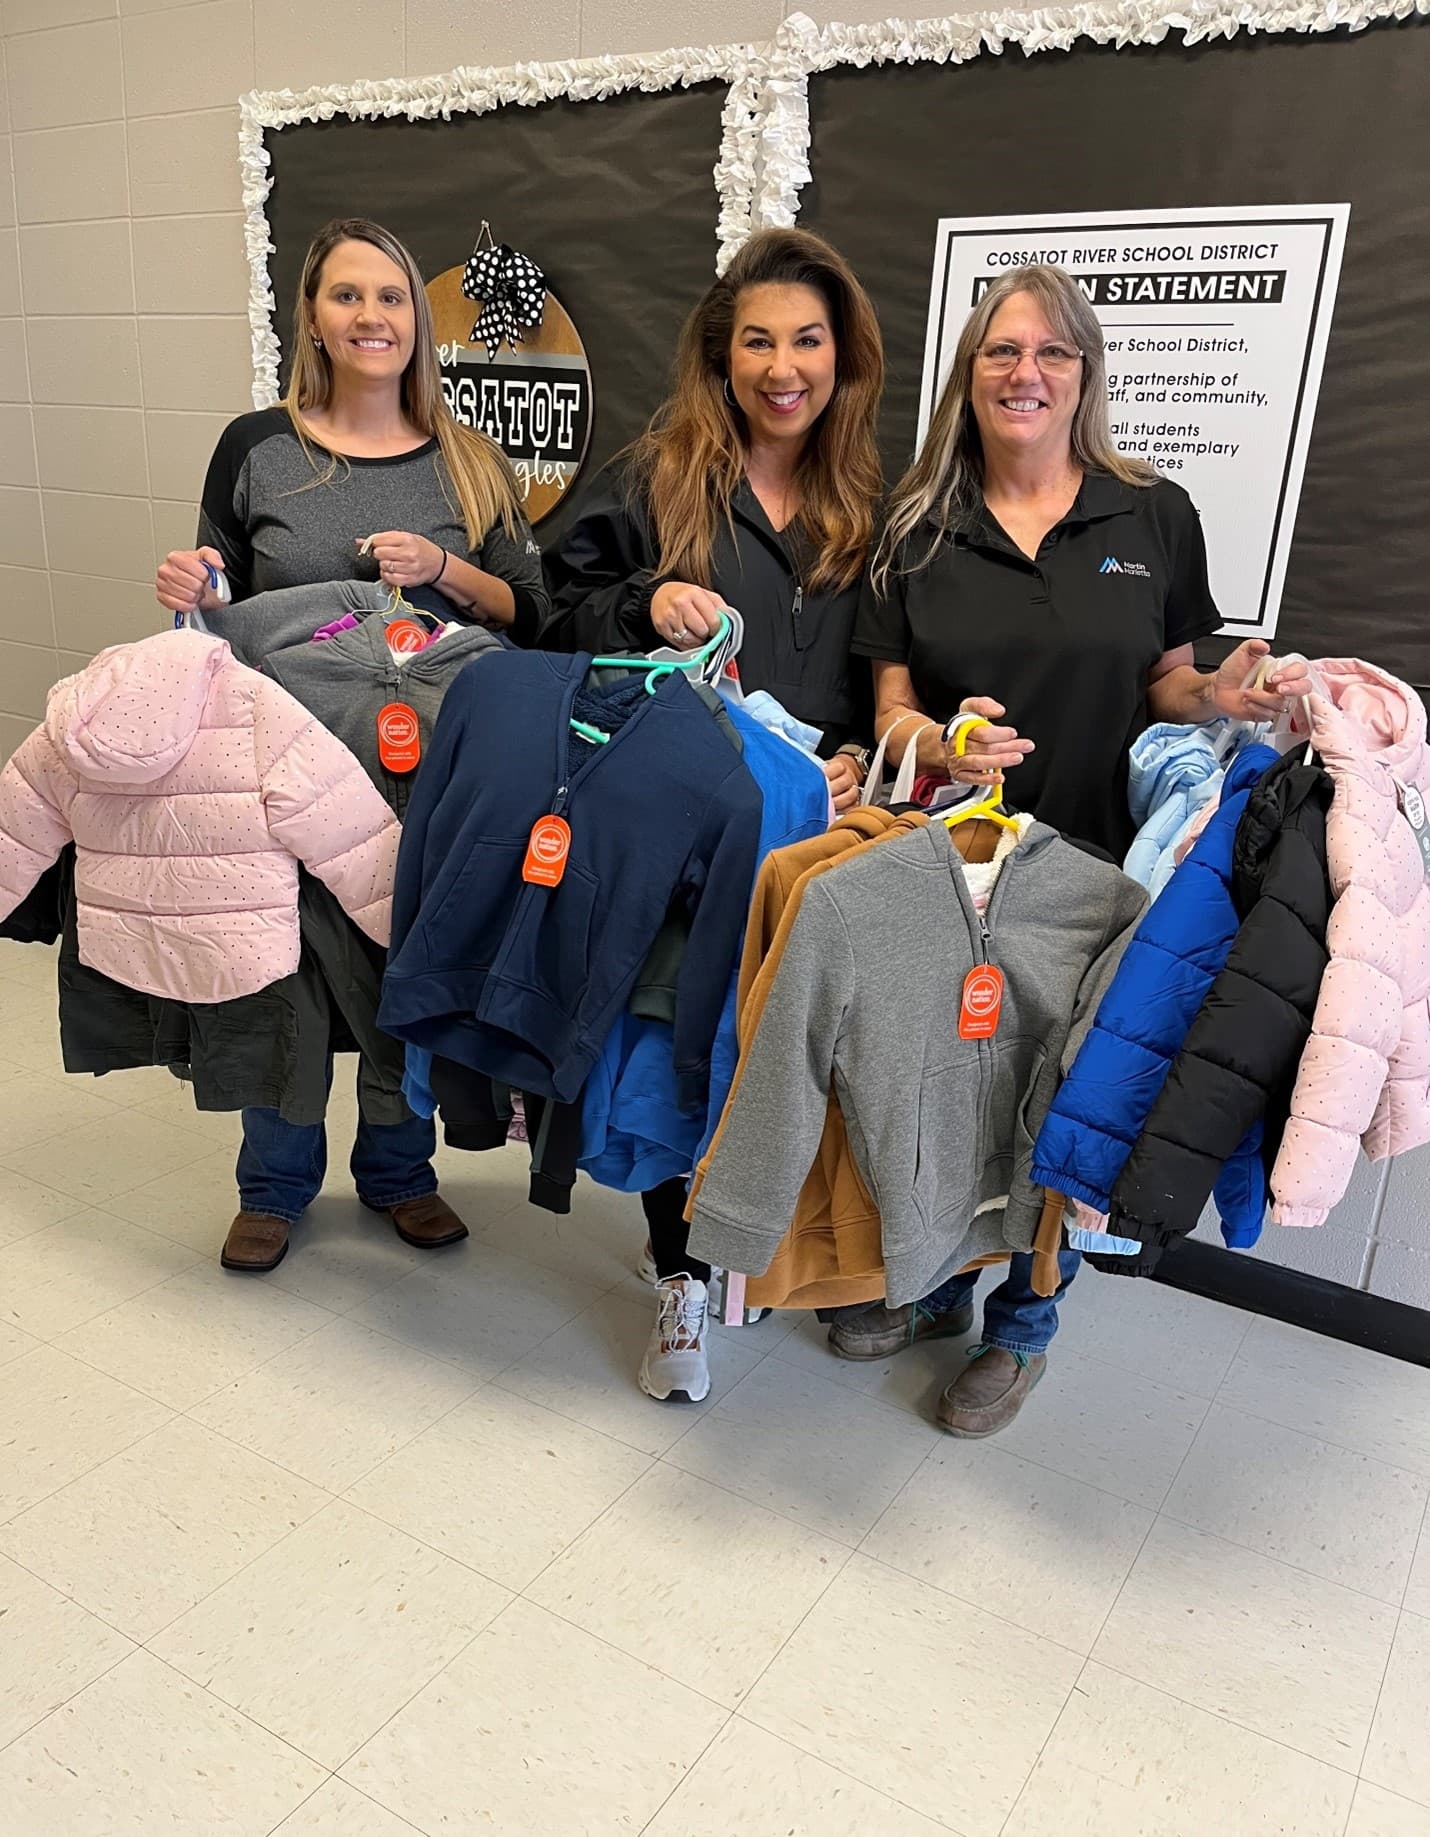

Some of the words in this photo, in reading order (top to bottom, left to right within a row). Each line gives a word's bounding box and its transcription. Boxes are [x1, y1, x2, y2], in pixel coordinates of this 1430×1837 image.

[986, 250, 1068, 266] COSSATOT
[1073, 248, 1117, 264] RIVER
[1122, 246, 1194, 262] SCHOOL
[1201, 244, 1278, 260] DISTRICT
[1106, 275, 1278, 301] STATEMENT
[1127, 338, 1182, 352] School
[1187, 338, 1248, 353] District,
[1122, 372, 1216, 389] partnership
[1221, 373, 1239, 387] of
[1108, 389, 1129, 403] aff,
[1135, 389, 1167, 403] and
[1171, 390, 1269, 407] community,
[440, 376, 580, 449] SSATOT
[1110, 422, 1129, 435] all
[1133, 422, 1200, 437] students
[1117, 439, 1149, 452] and
[1153, 440, 1240, 457] exemplary
[515, 450, 566, 502] gles
